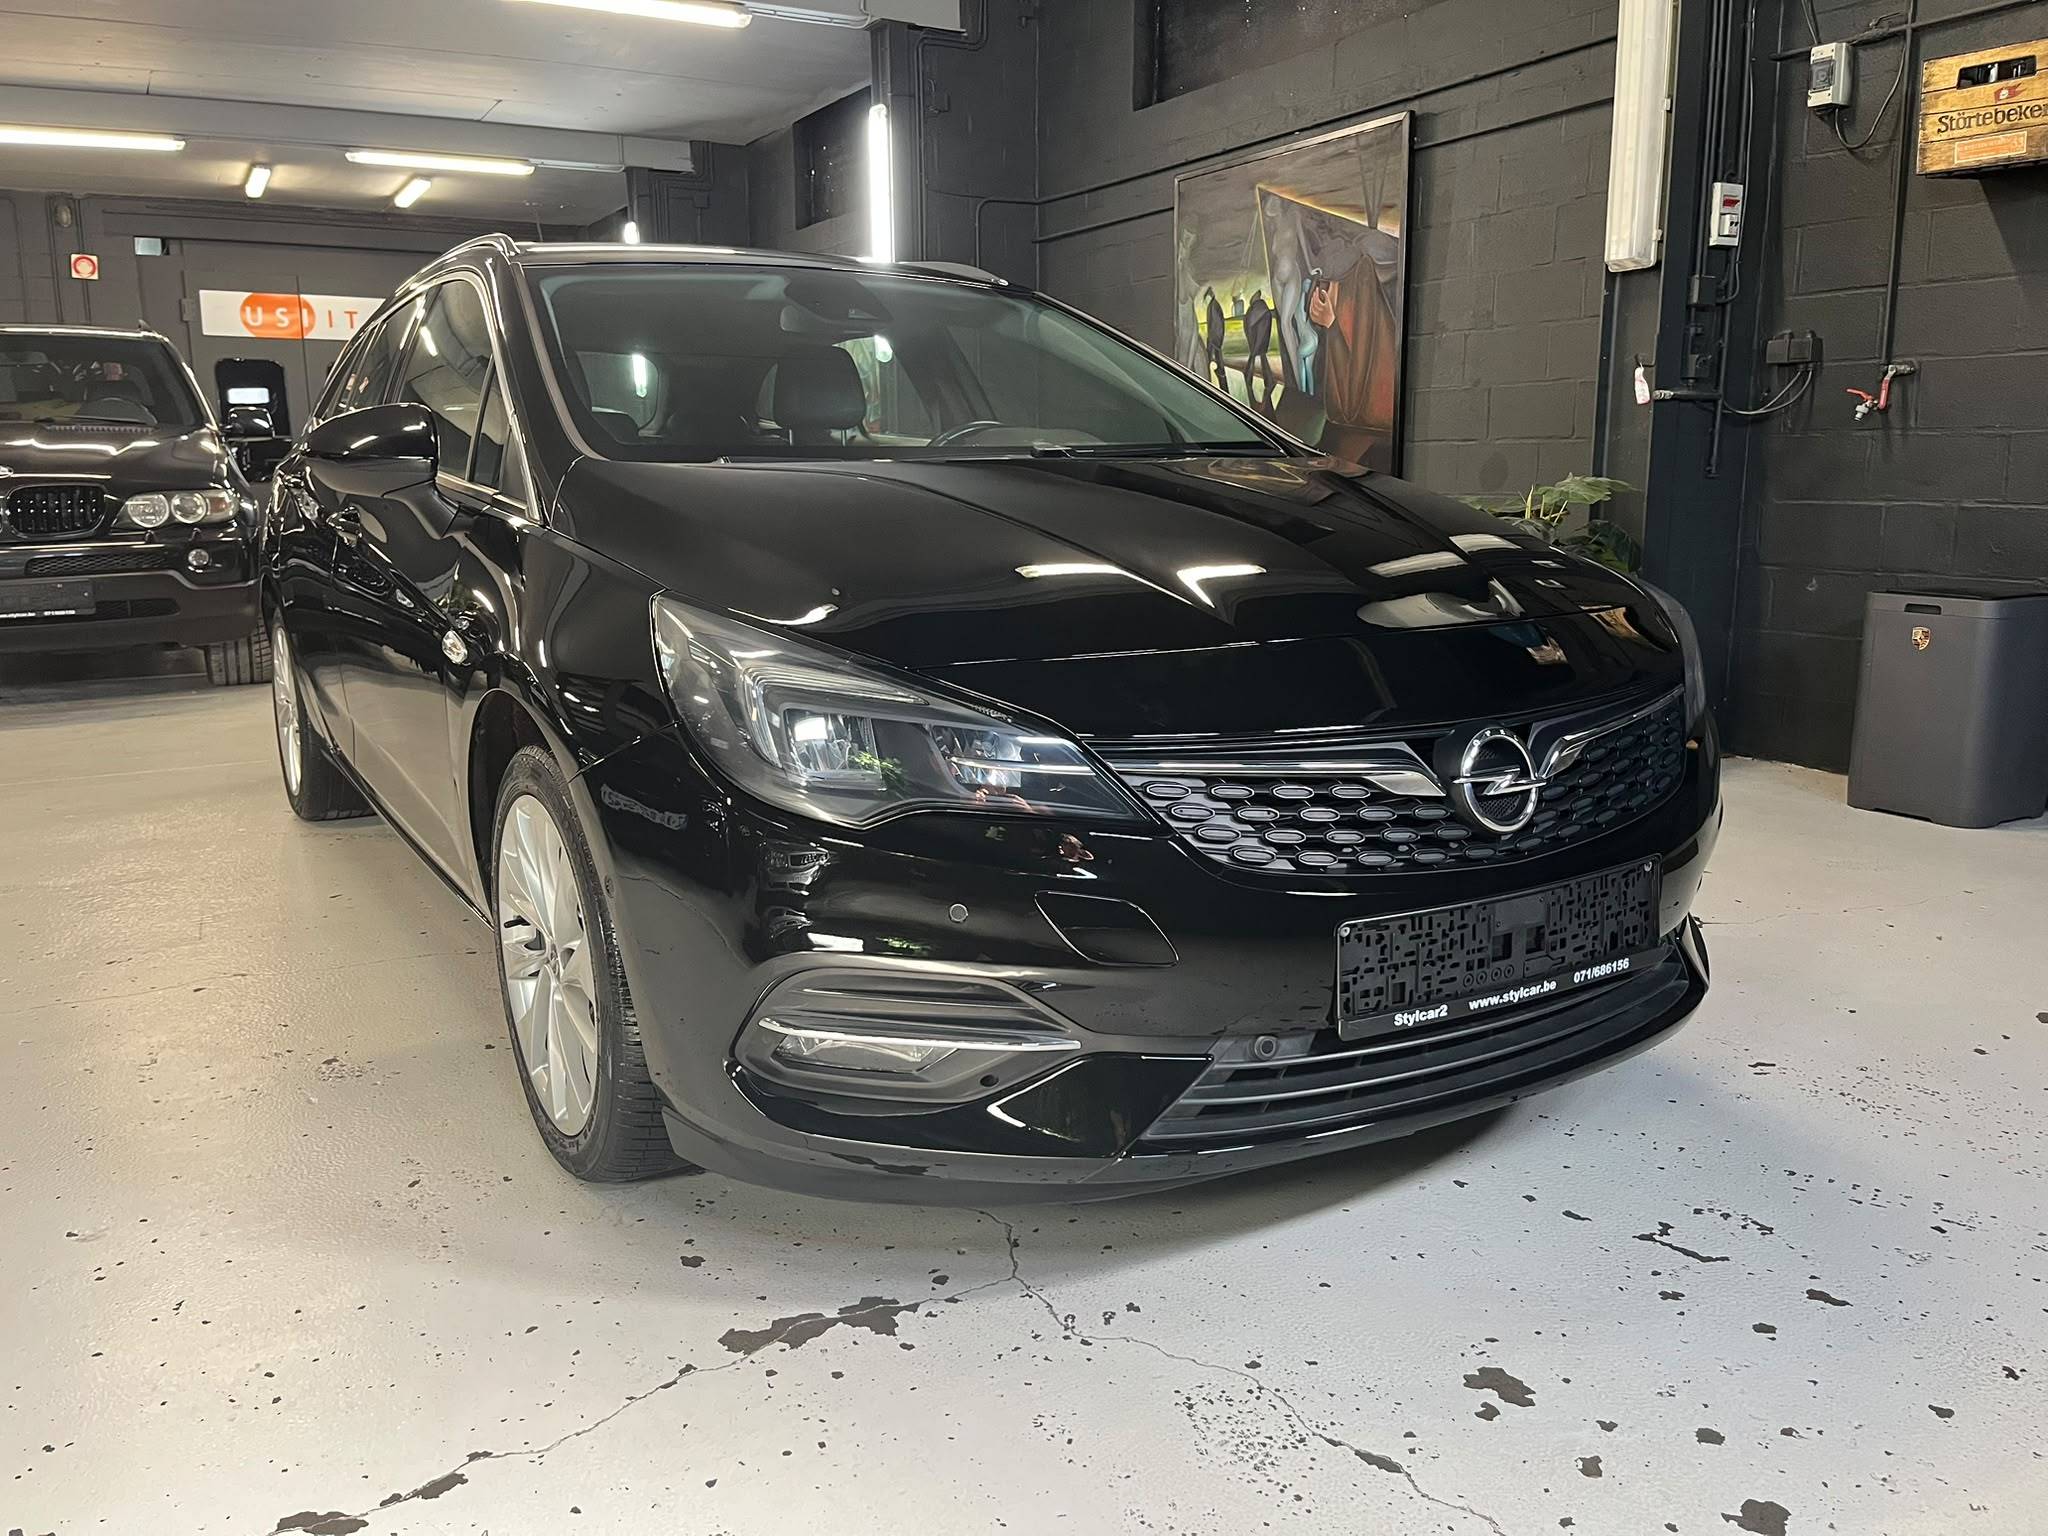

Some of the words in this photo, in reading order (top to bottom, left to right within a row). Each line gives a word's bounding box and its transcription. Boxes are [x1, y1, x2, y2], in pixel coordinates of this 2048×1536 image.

[1393, 1004, 1448, 1027] Stylcar2
[1468, 980, 1557, 1011] www.stylcar.be
[1573, 958, 1630, 983] 071/686156
